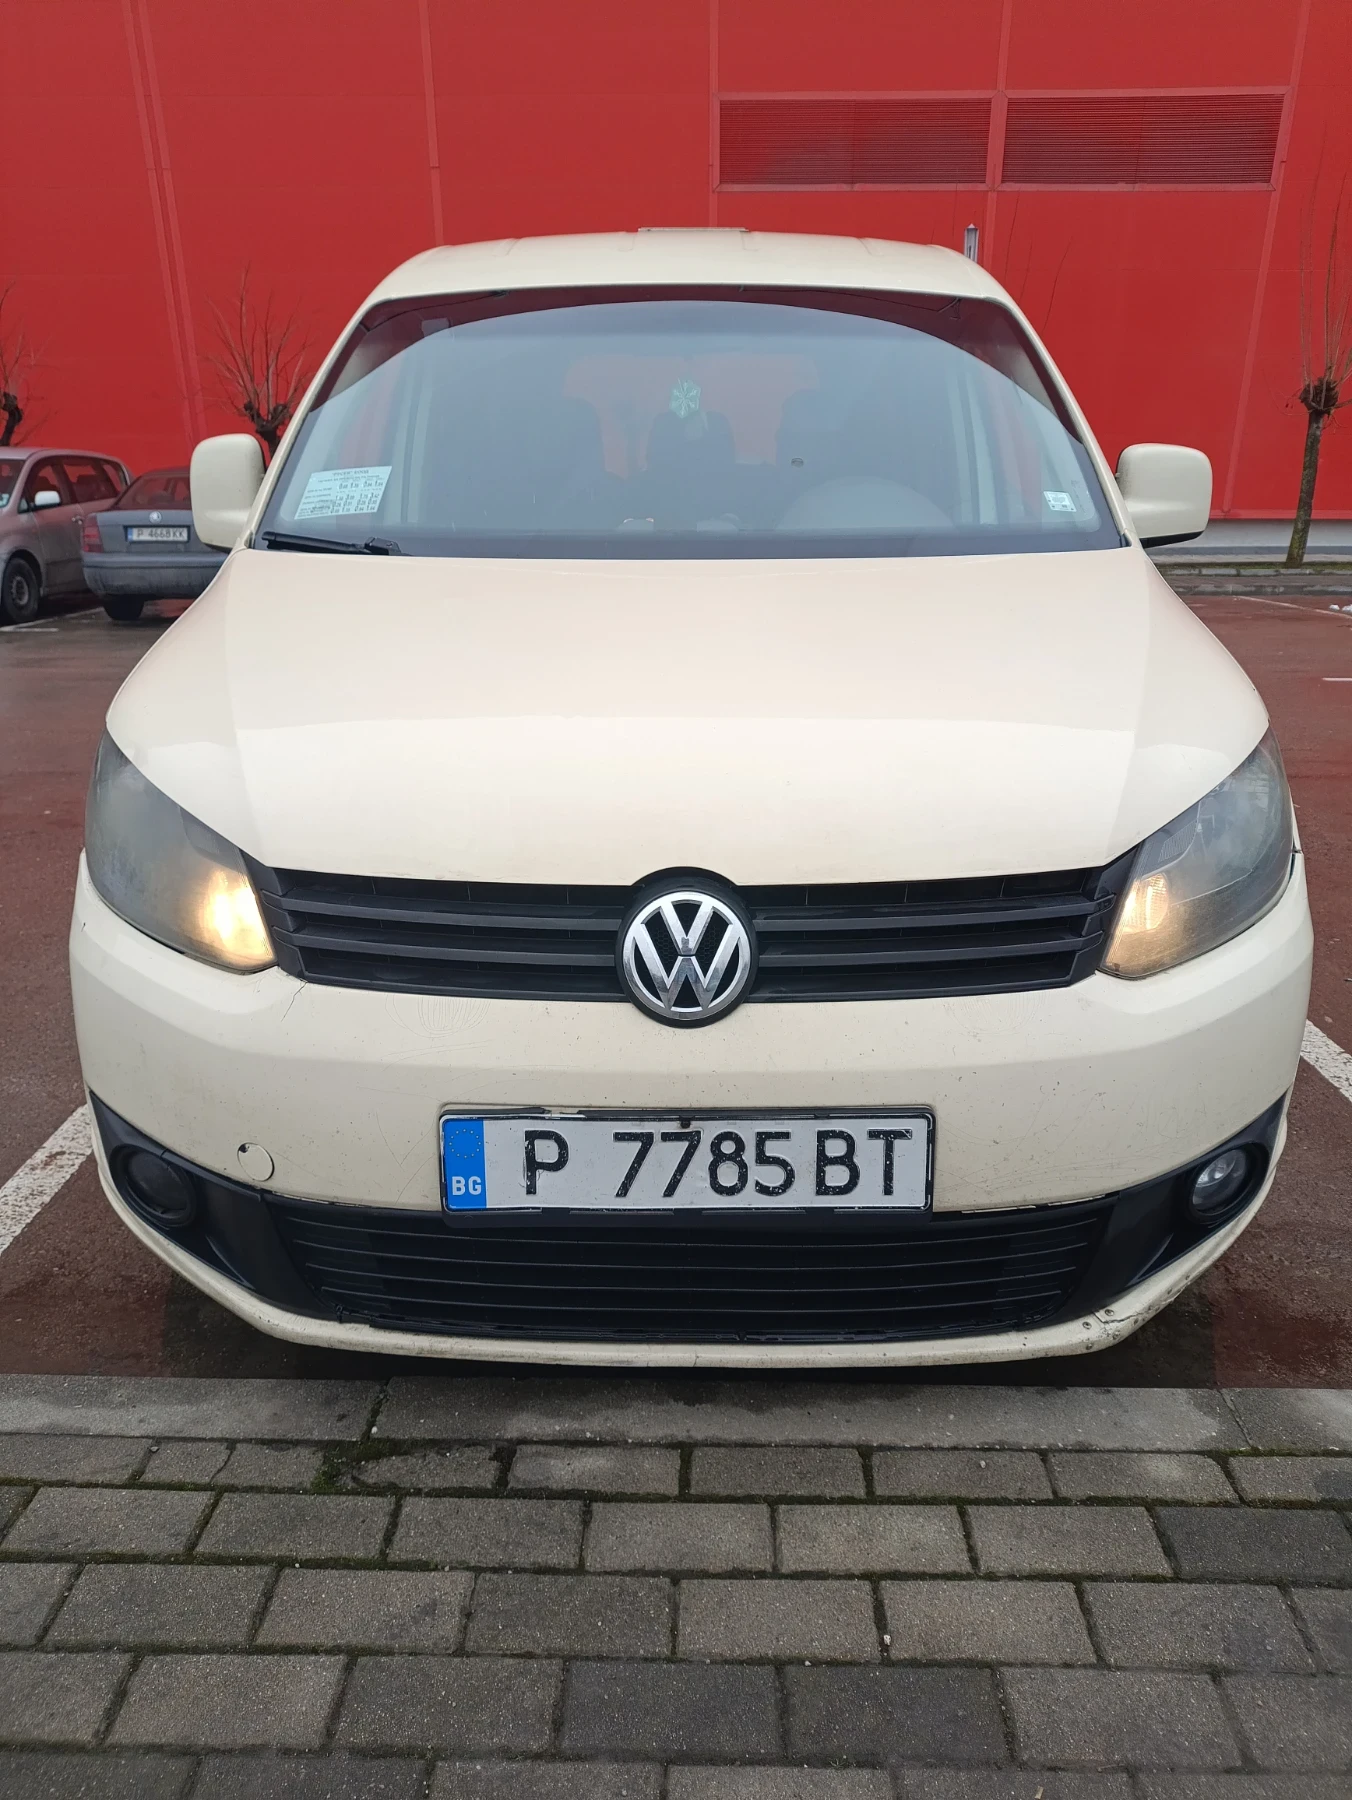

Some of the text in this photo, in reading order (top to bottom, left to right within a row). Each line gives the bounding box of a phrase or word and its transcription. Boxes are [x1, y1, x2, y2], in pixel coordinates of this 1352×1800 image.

[137, 528, 144, 538] P
[173, 528, 184, 538] KK
[623, 892, 751, 1021] VW
[452, 1176, 481, 1196] BG
[524, 1128, 913, 1199] P 7785 BT
